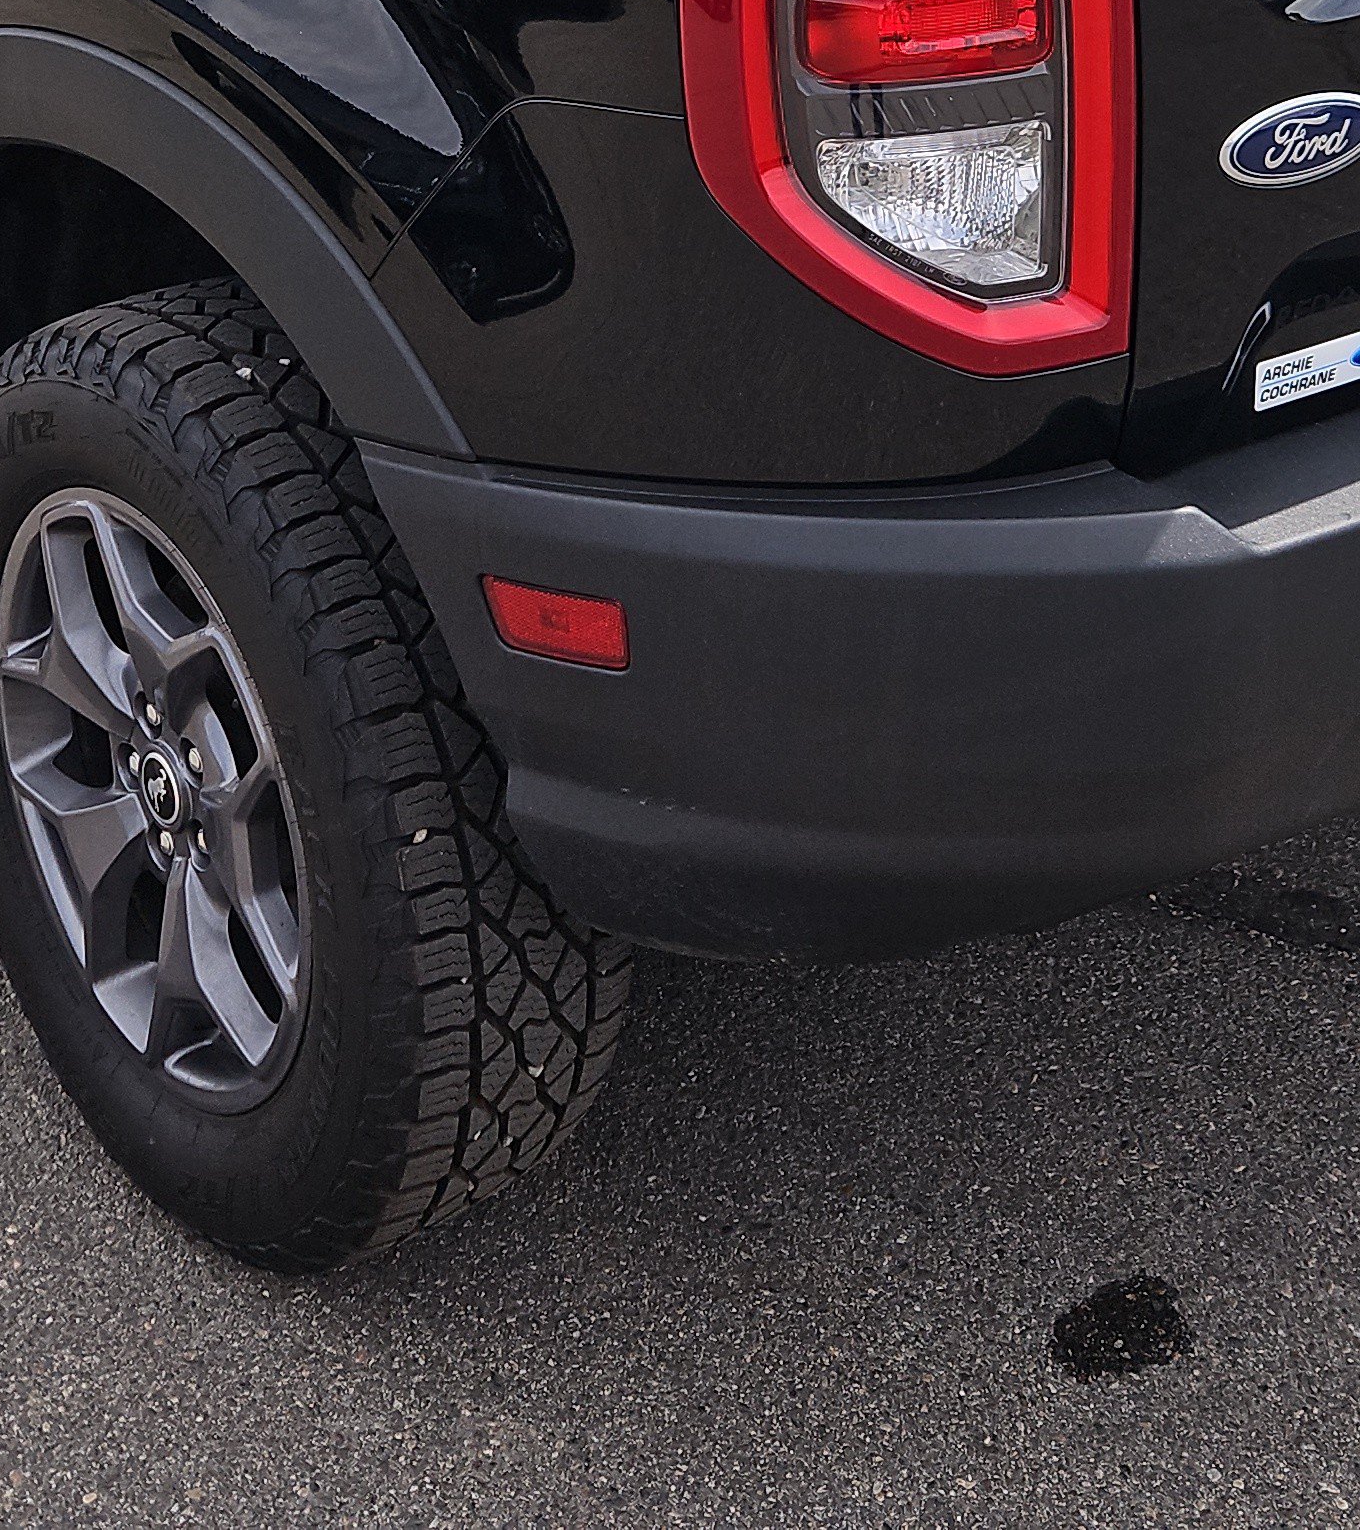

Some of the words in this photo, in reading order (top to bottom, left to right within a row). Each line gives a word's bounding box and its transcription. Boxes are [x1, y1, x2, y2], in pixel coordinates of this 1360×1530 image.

[1264, 113, 1351, 169] Ford
[1260, 367, 1337, 403] COCHRANE
[1261, 355, 1314, 384] ARCHIE
